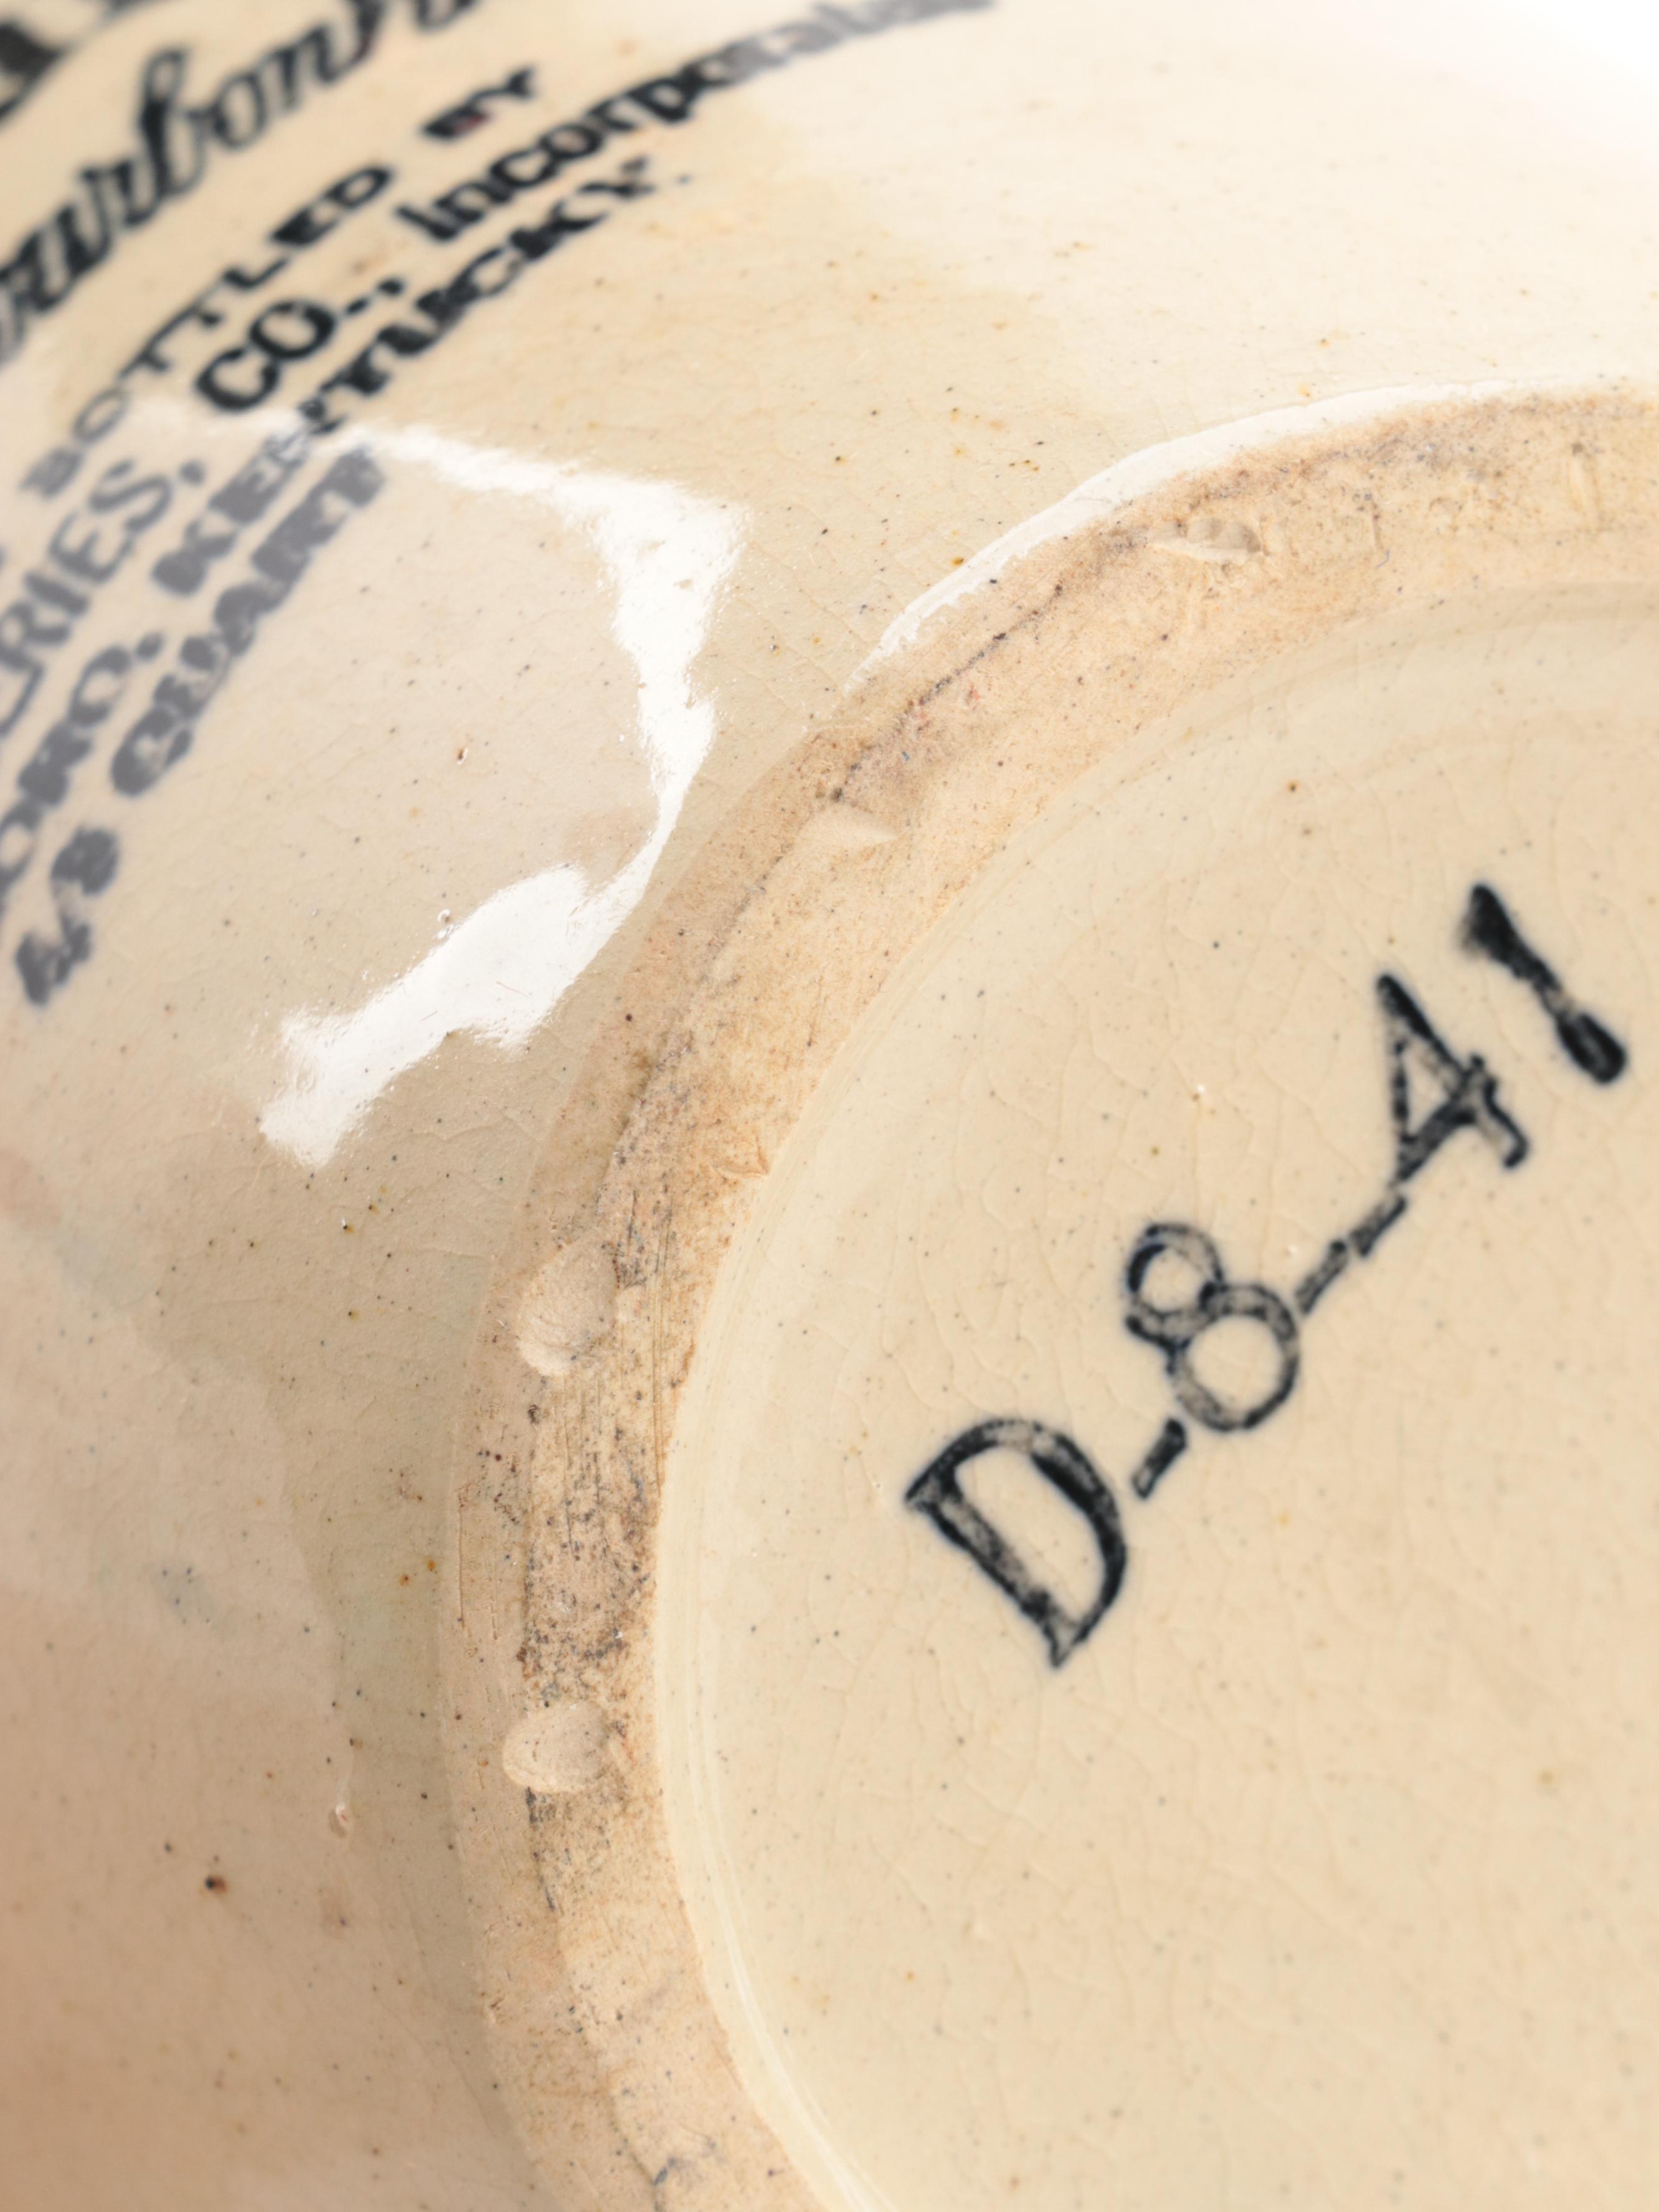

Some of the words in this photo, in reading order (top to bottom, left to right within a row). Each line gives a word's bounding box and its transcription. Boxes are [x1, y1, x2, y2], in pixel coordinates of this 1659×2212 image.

[21, 165, 394, 495] BOTTLED
[423, 67, 532, 138] BY
[0, 458, 204, 738] RIES,
[111, 448, 384, 794] QUART
[904, 883, 1628, 1670] D-8-41
